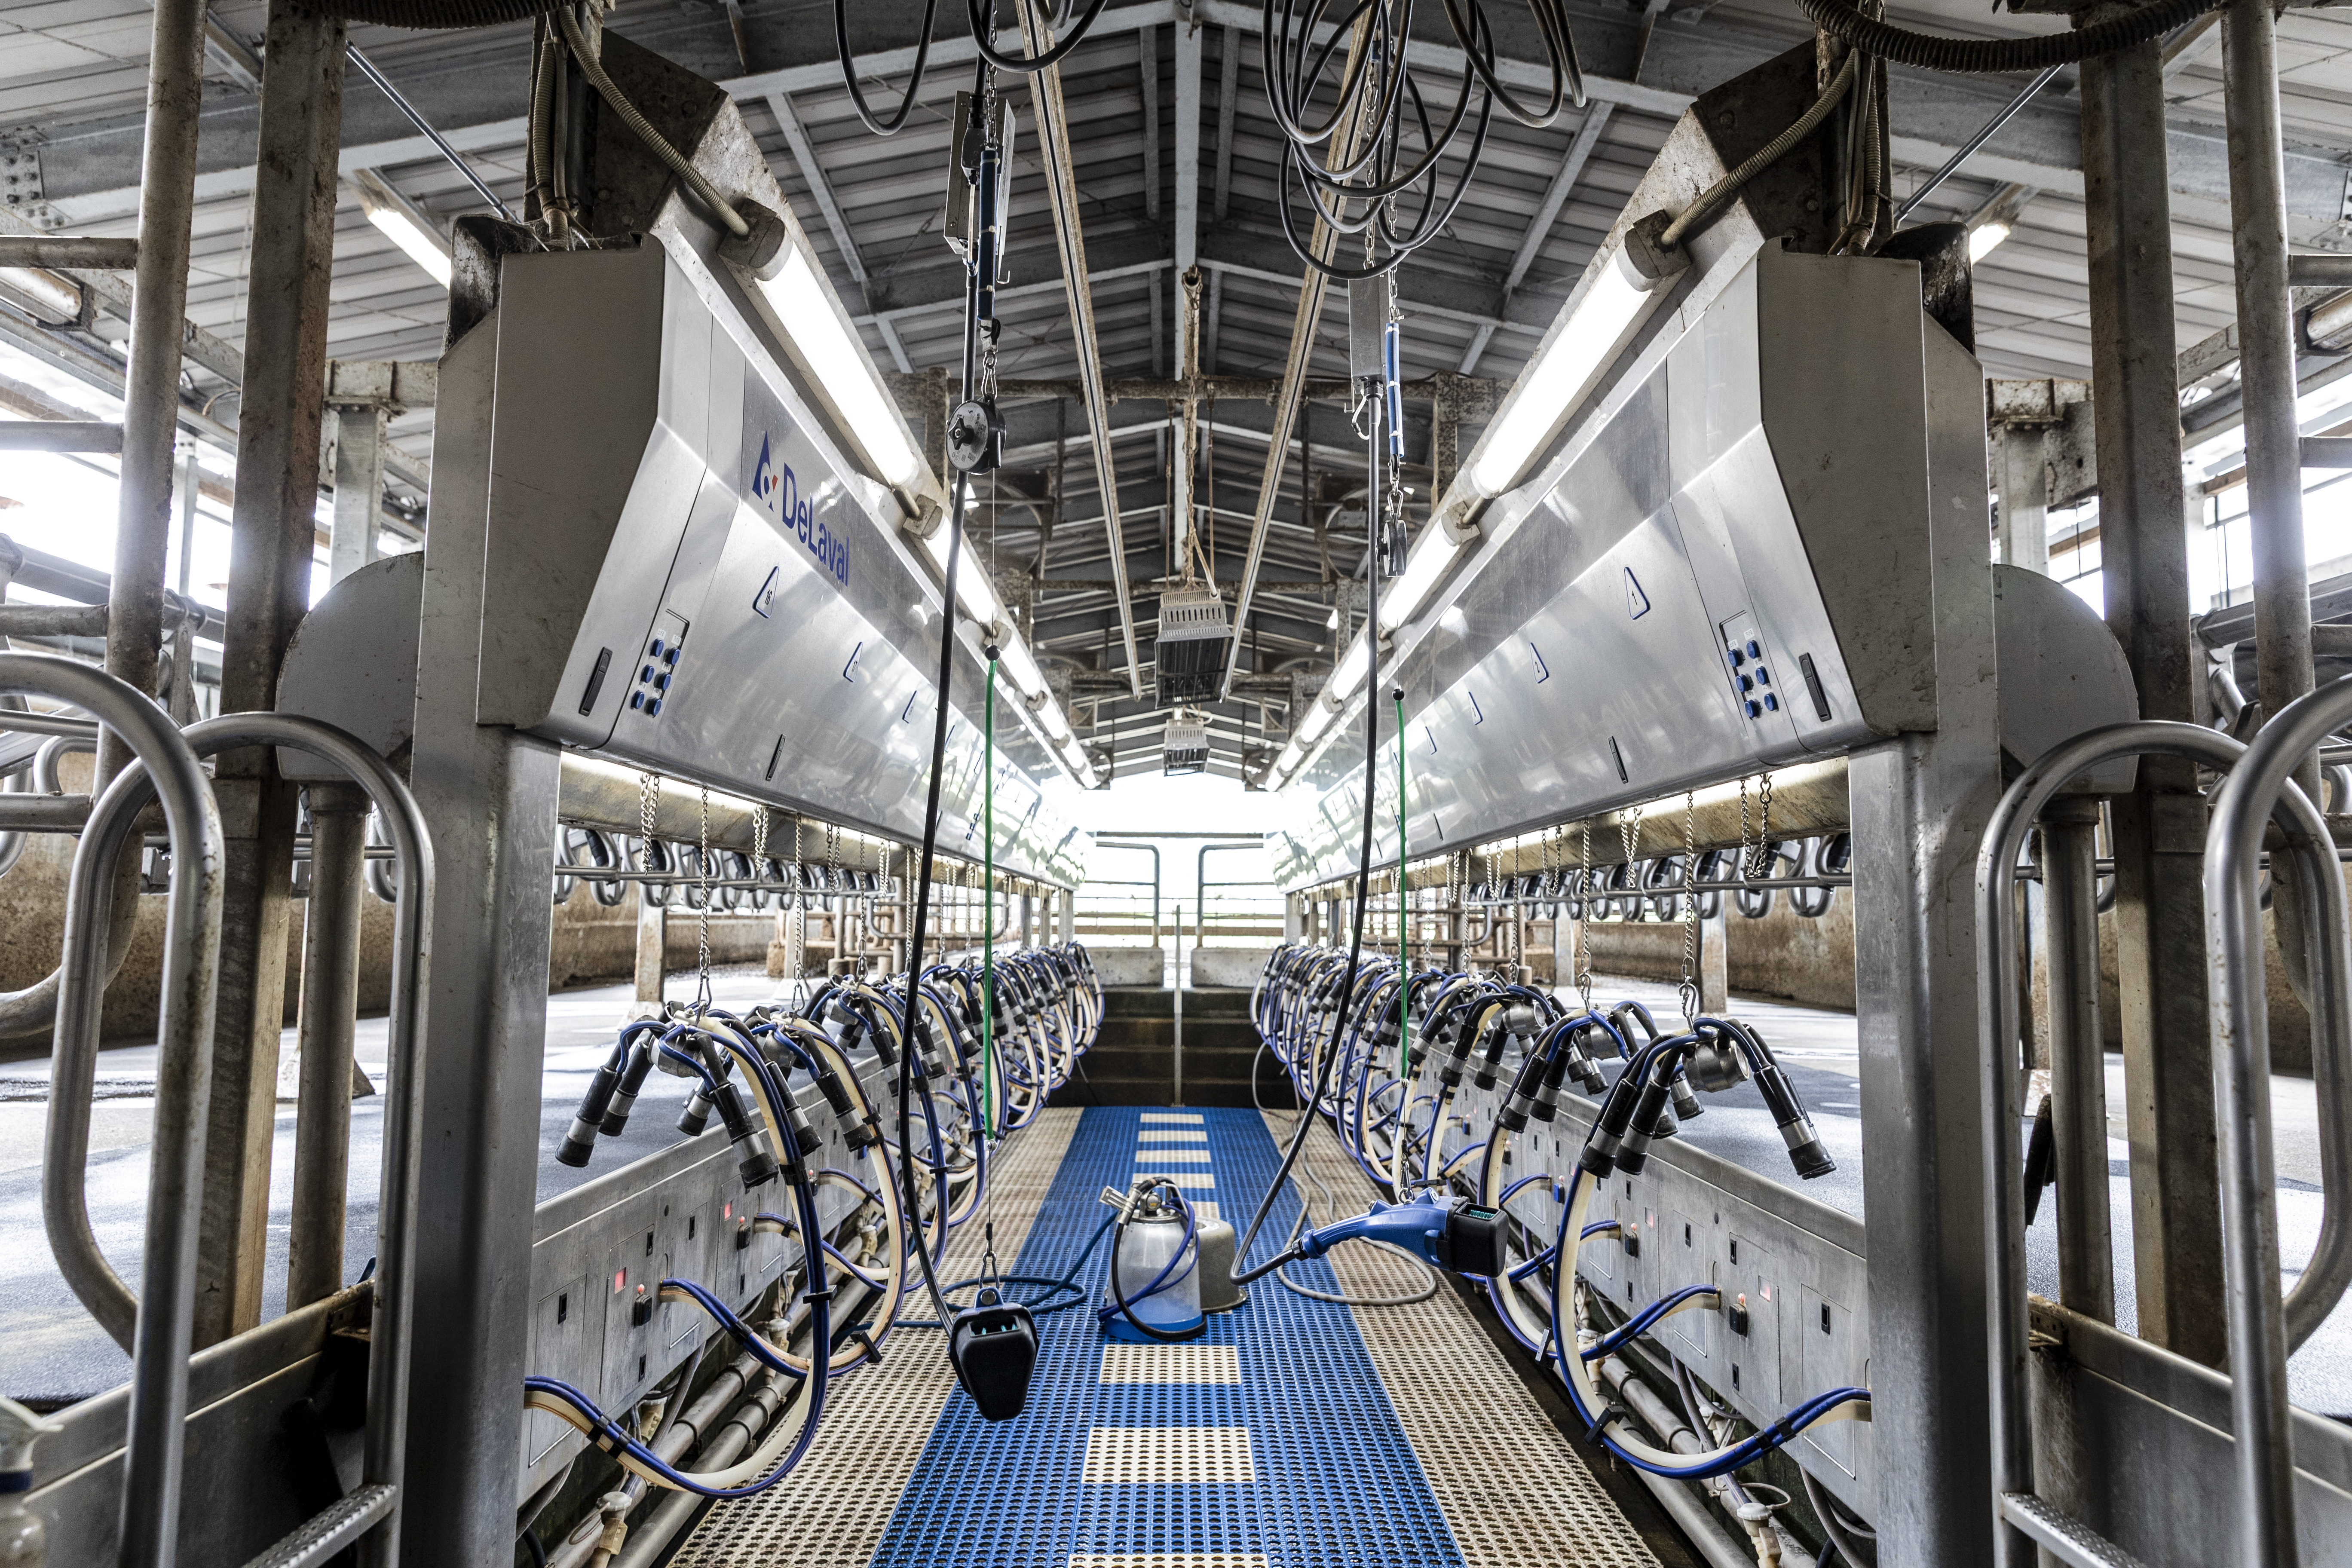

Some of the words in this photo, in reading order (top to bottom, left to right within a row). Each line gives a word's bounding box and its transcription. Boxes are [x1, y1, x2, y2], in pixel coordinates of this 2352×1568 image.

[782, 462, 849, 587] DeLaval
[764, 589, 772, 606] 16
[1632, 591, 1638, 606] 1
